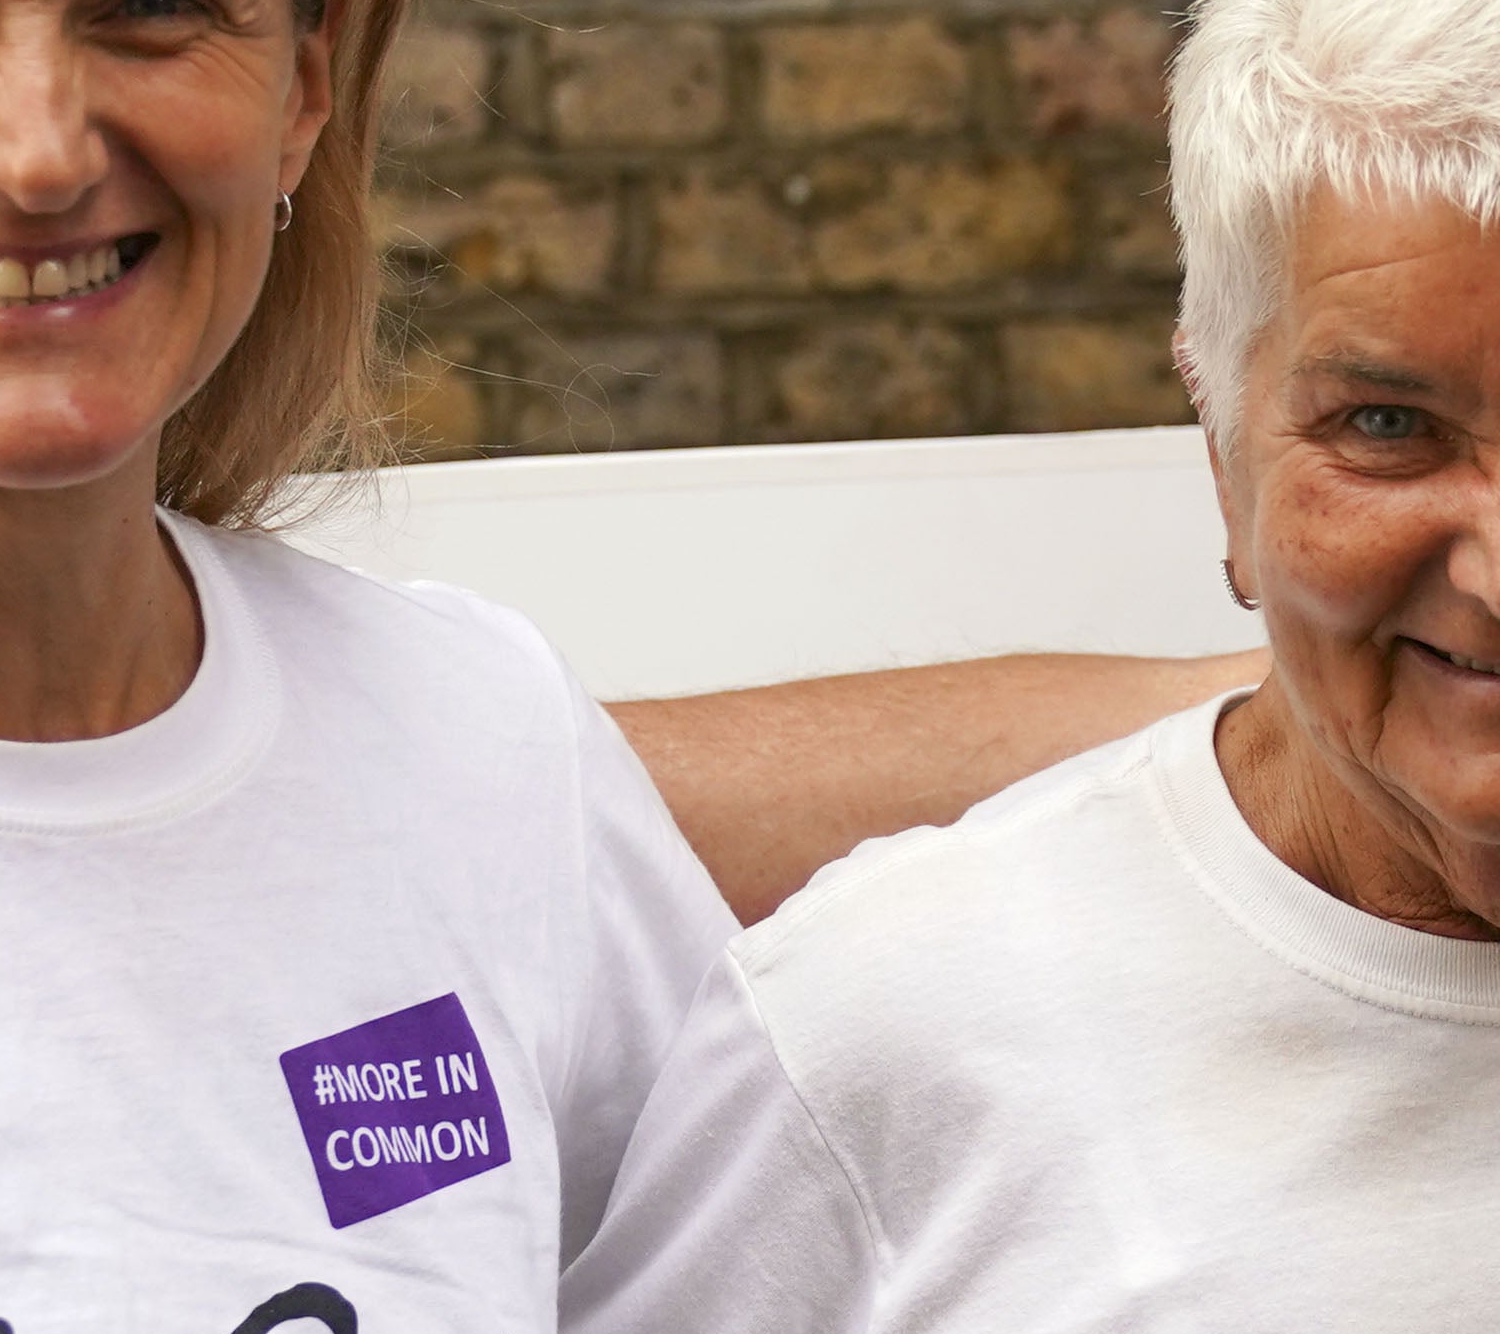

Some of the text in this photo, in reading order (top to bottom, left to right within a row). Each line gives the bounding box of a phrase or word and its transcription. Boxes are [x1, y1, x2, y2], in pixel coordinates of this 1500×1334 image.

[312, 1051, 479, 1106] #MORE IN
[325, 1116, 490, 1171] COMMON
